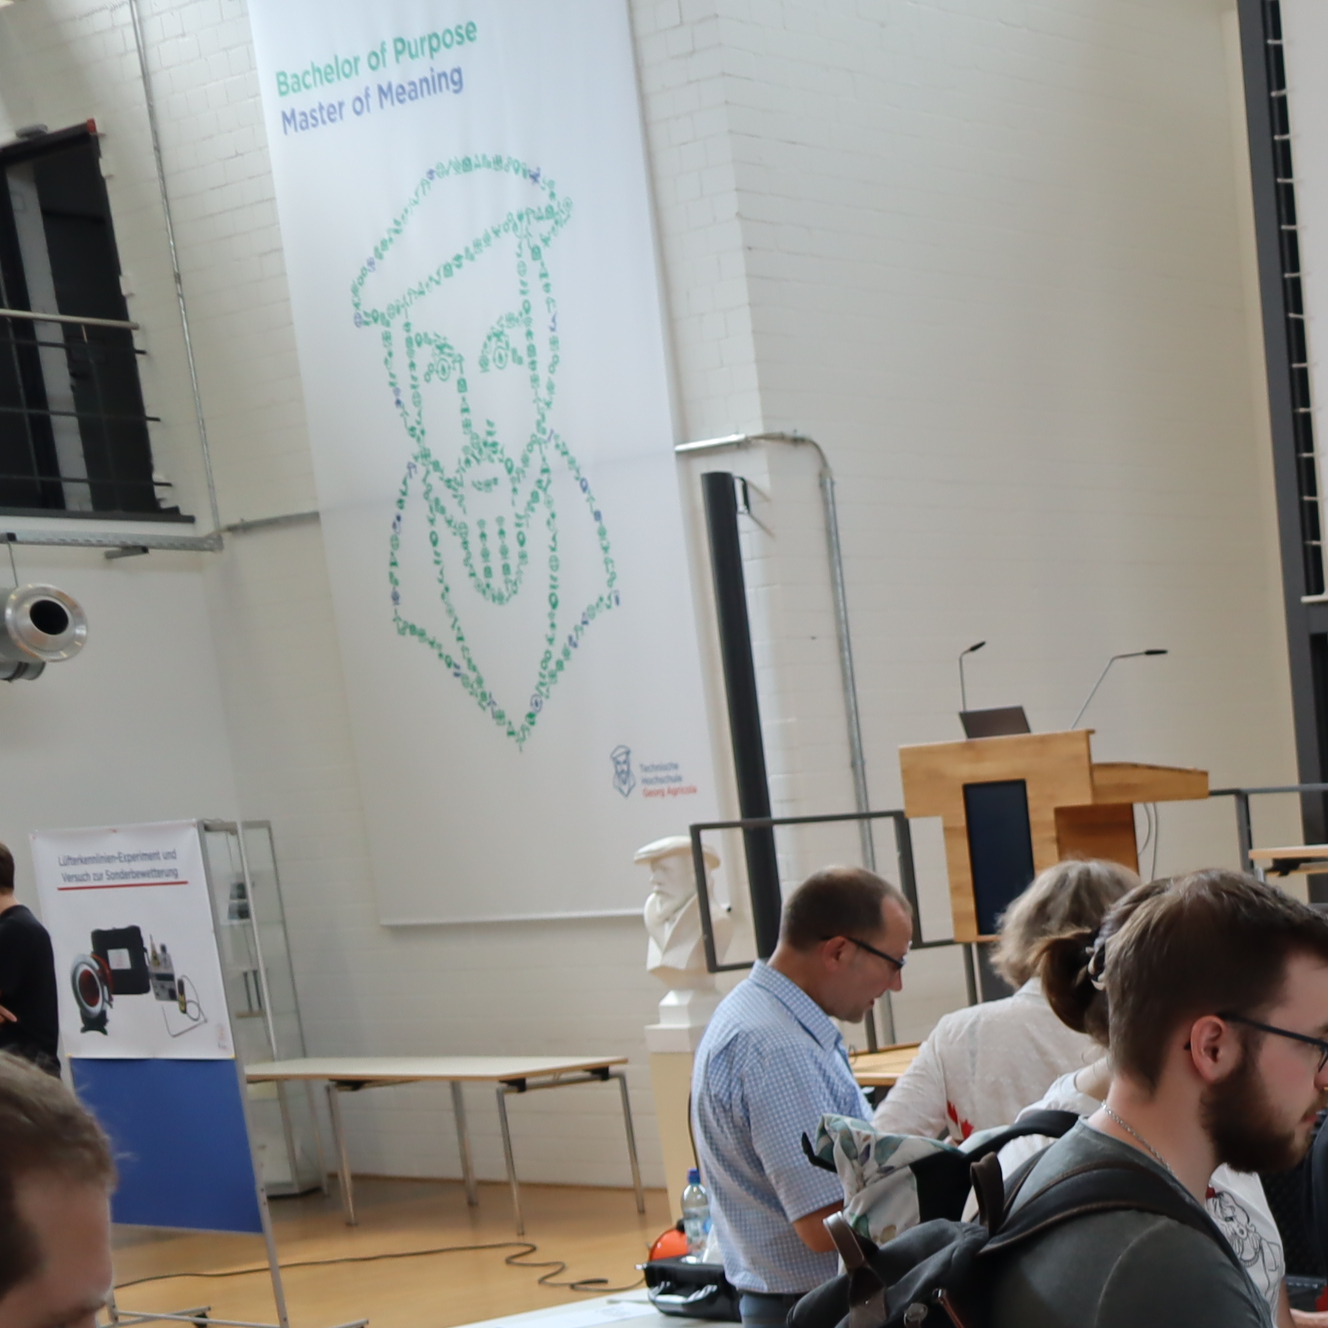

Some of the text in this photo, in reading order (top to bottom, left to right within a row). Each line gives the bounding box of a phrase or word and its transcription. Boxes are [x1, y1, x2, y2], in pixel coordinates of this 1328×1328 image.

[276, 20, 478, 97] Bachelor of Purpose
[281, 66, 464, 136] Master of Meaning
[161, 848, 178, 861] und
[61, 871, 92, 883] Versuch
[92, 872, 104, 882] zur
